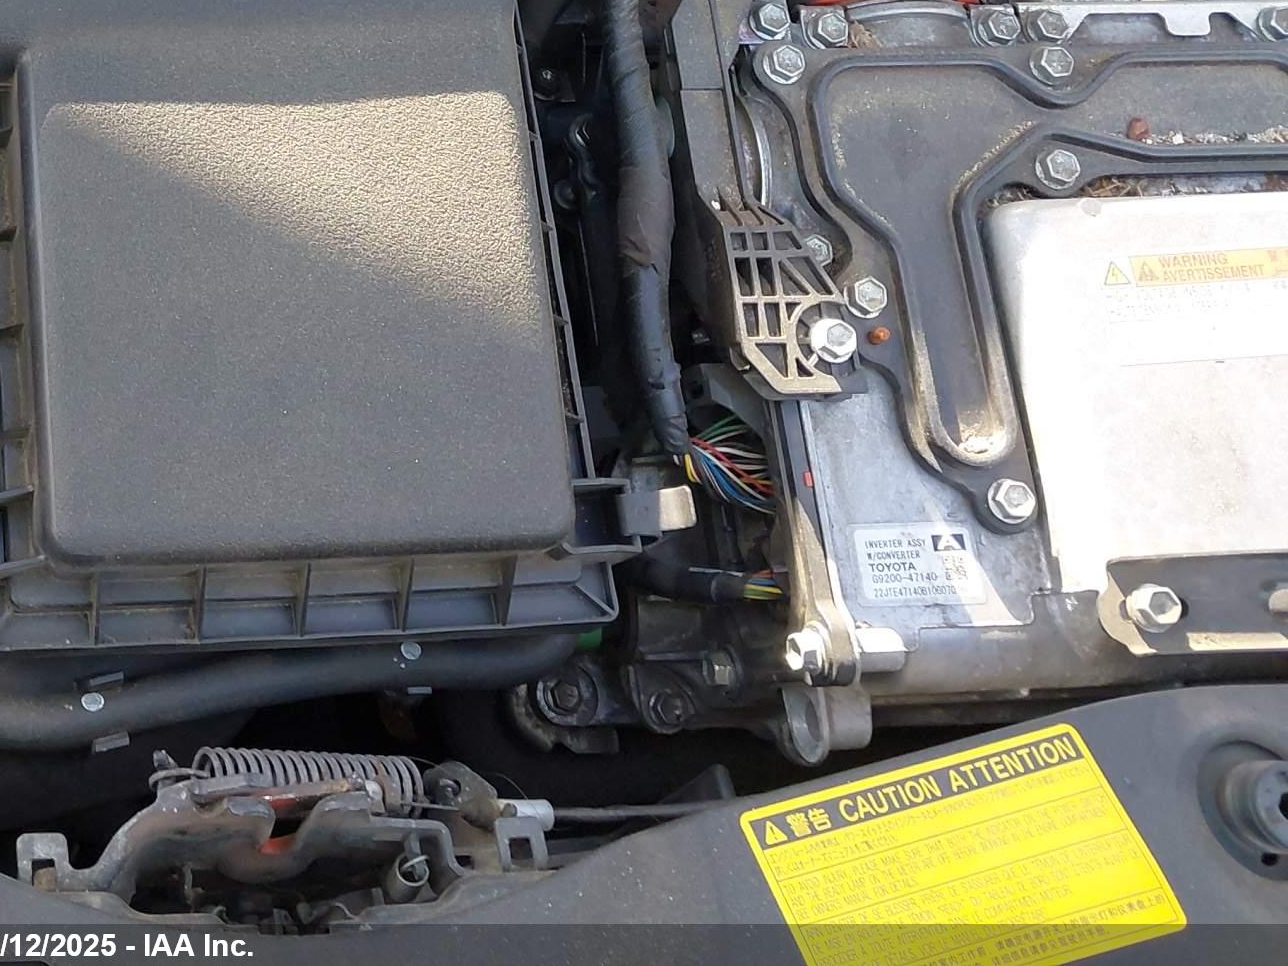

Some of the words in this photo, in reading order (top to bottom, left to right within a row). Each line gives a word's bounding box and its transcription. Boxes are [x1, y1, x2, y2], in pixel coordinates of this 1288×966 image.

[1158, 253, 1229, 268] WARNING
[1162, 264, 1265, 283] AVERTISSEMENT
[864, 538, 903, 549] INVERTER
[907, 538, 926, 547] ASSY
[868, 562, 917, 573] TOYOTA
[872, 572, 938, 584] G9200-47140
[786, 804, 833, 838] 警告
[836, 773, 942, 824] CAUTION
[945, 734, 1078, 793] ATTENTION
